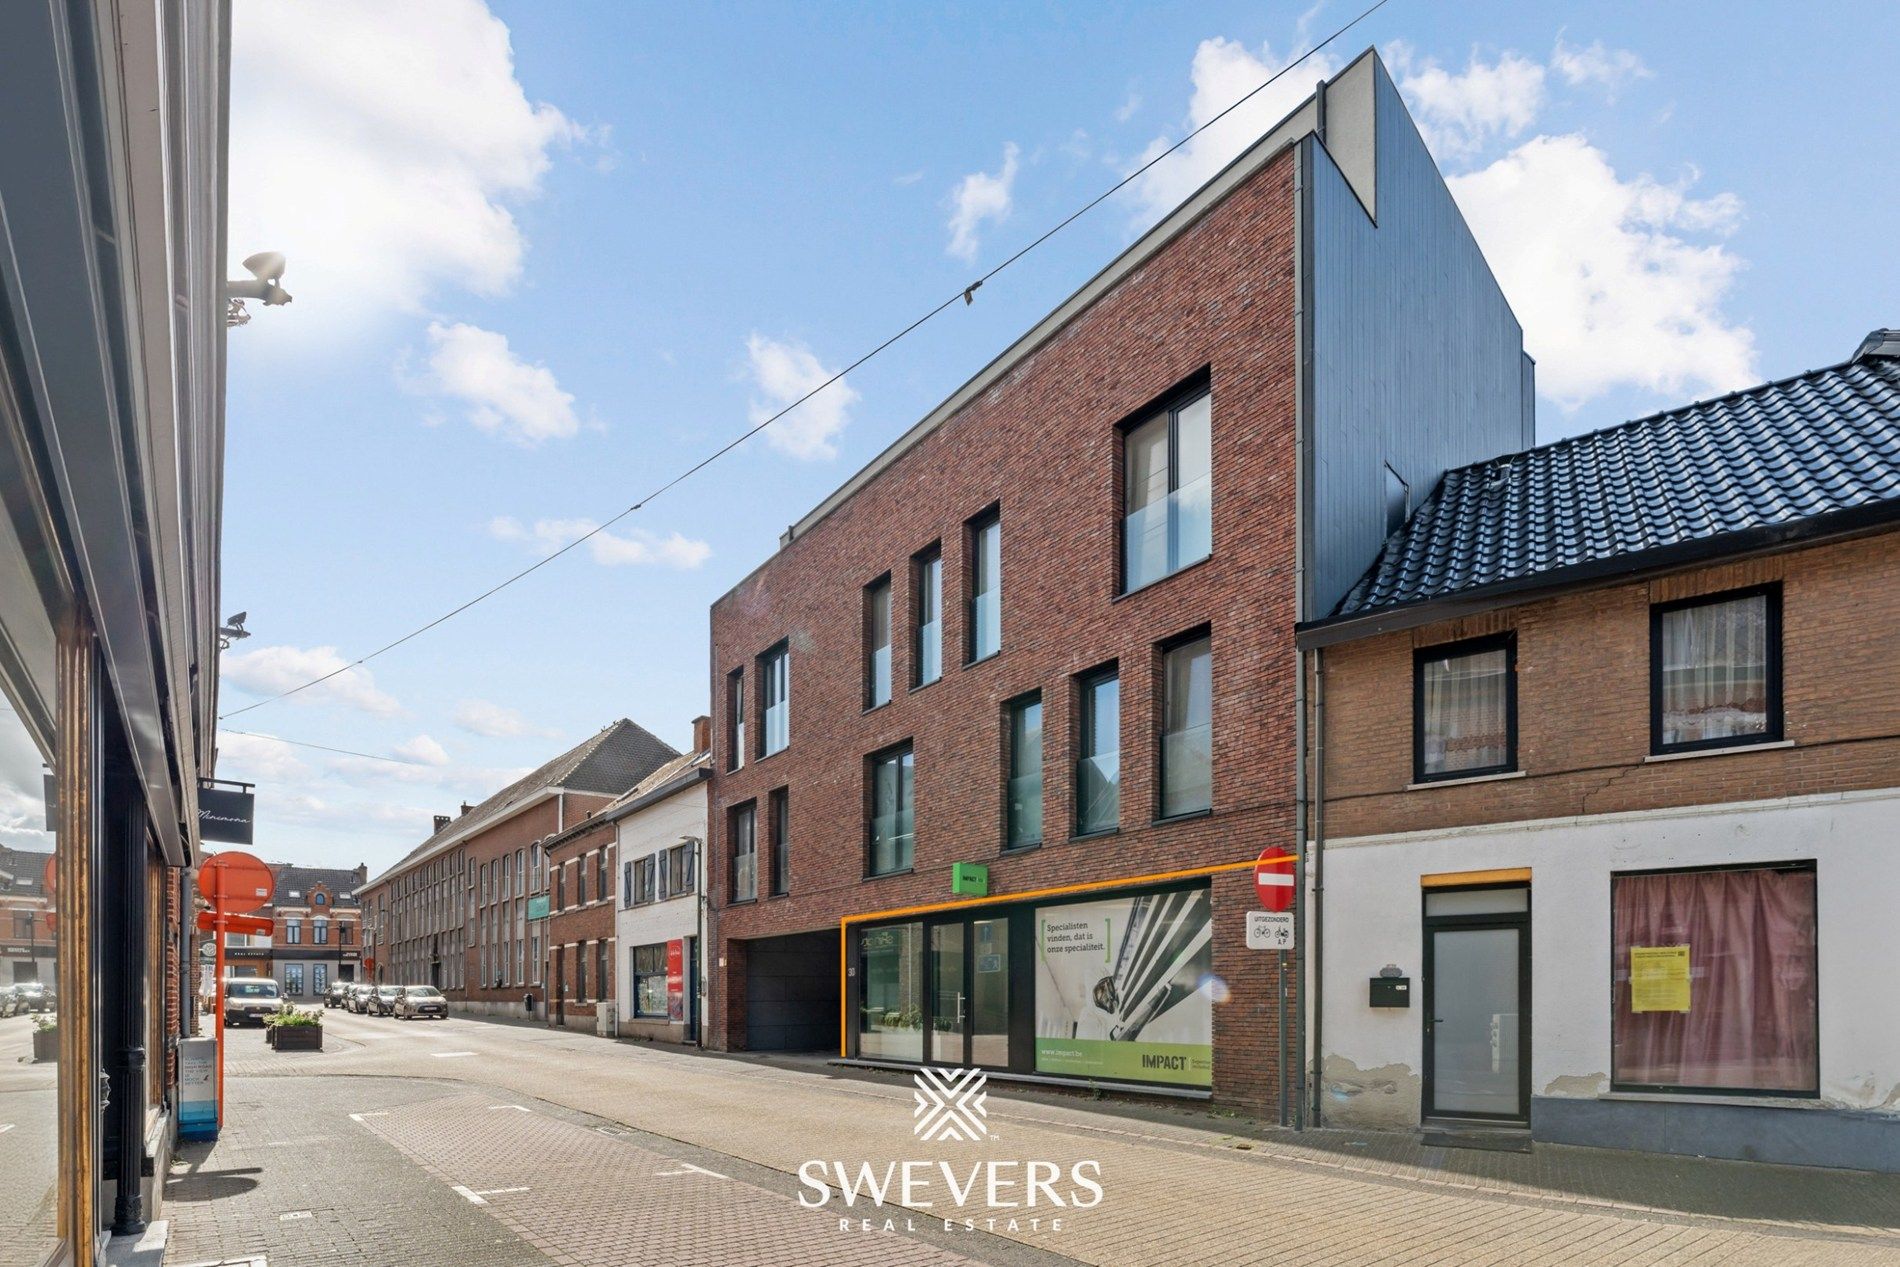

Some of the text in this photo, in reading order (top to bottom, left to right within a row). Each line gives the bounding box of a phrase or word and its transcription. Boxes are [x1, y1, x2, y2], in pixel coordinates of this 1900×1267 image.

[1046, 922, 1088, 933] Specialisten
[1046, 934, 1072, 942] vinden,
[1064, 943, 1105, 953] specialiteit.
[1142, 1054, 1185, 1071] IMPACT
